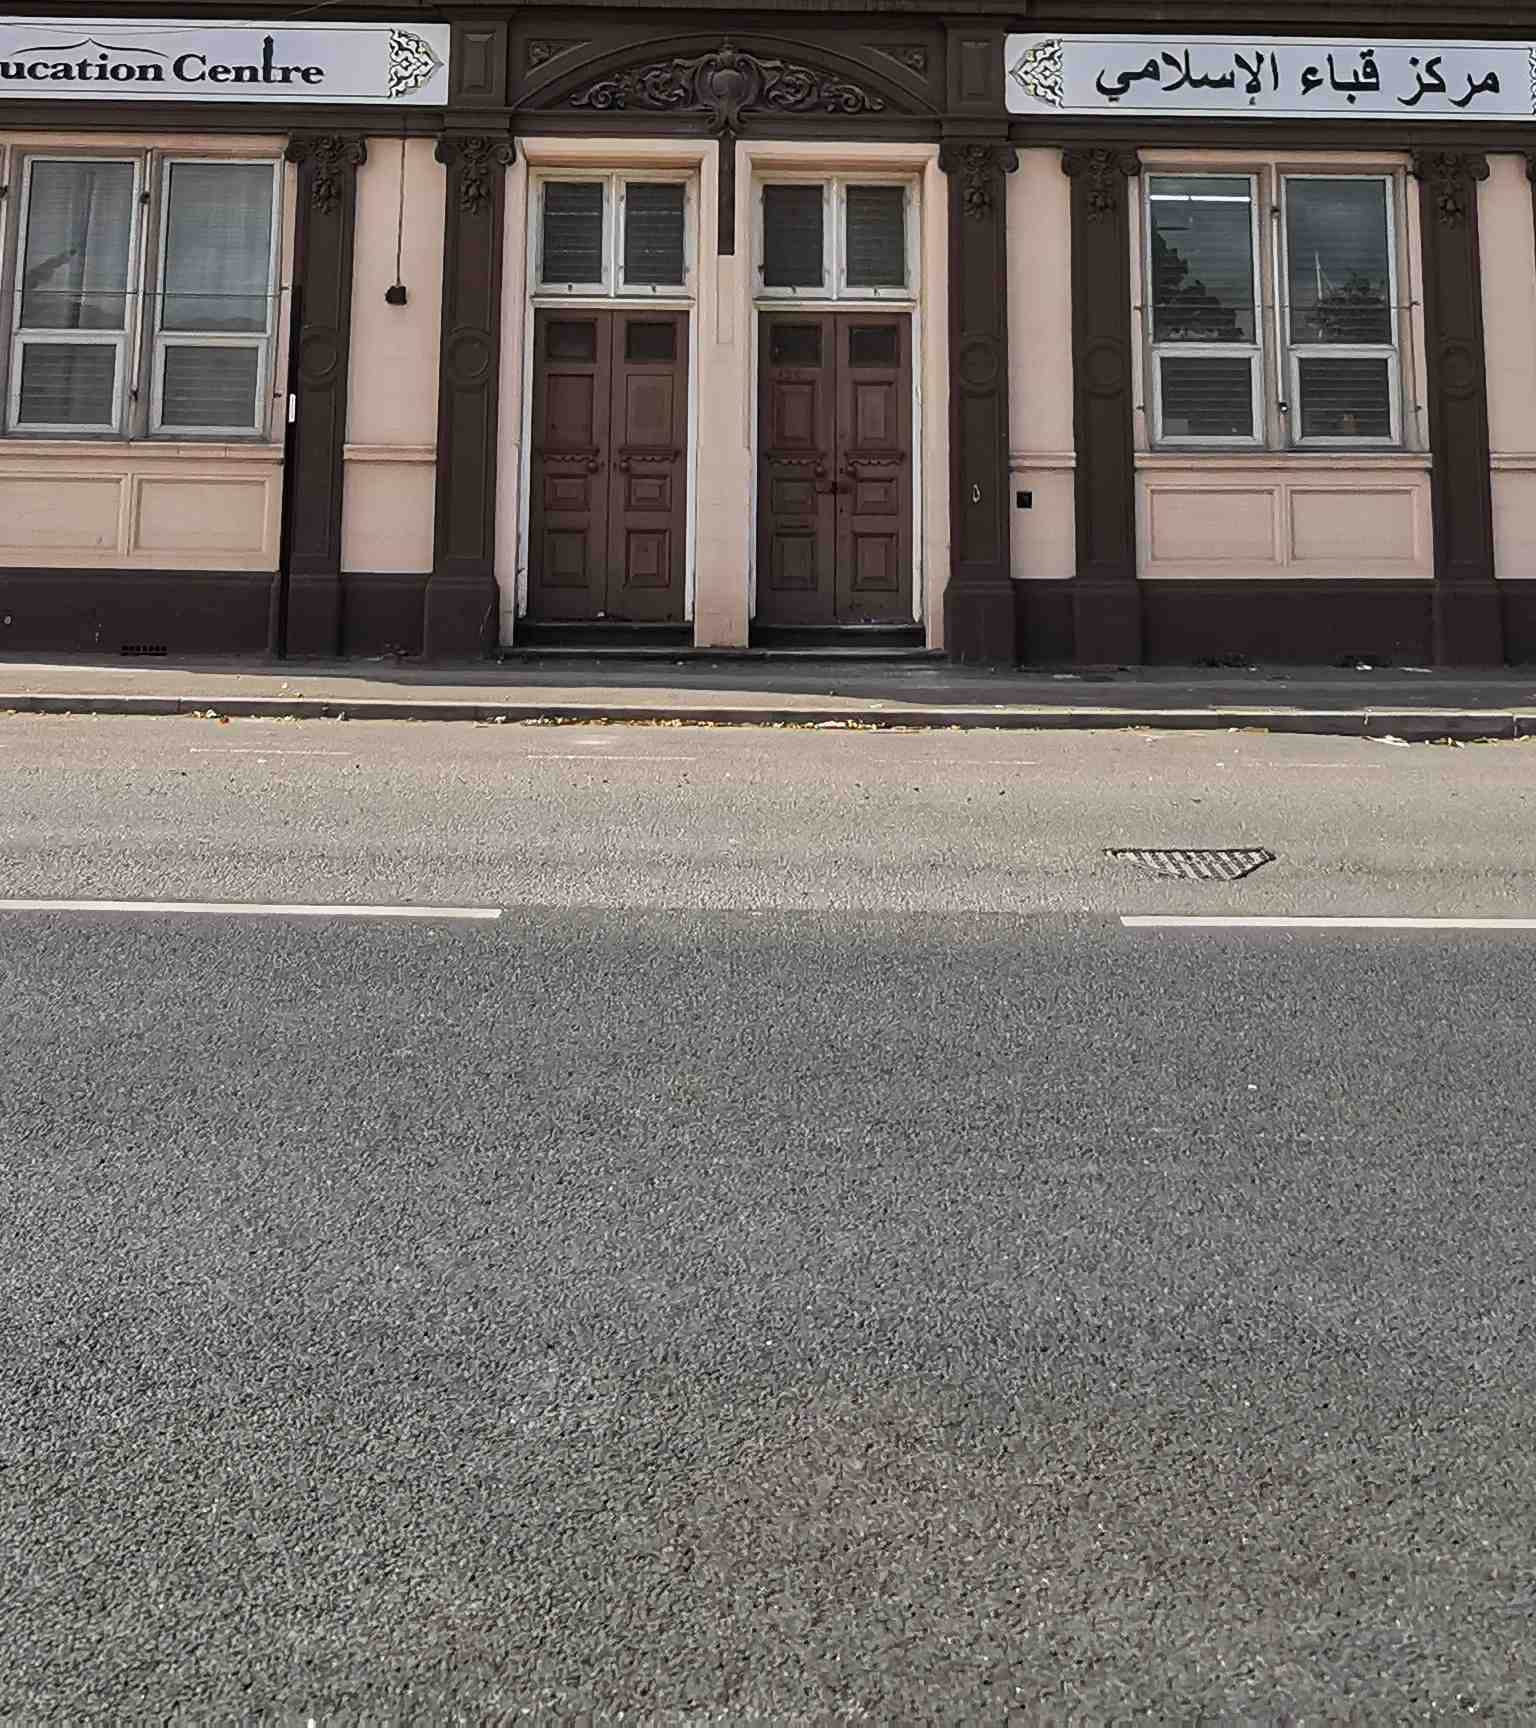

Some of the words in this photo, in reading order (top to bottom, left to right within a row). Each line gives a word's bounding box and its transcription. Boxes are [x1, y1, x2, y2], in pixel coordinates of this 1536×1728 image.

[172, 34, 325, 85] Centre
[1095, 48, 1279, 106] الإسلامي
[1300, 48, 1381, 106] قباء
[1396, 54, 1500, 109] مركز
